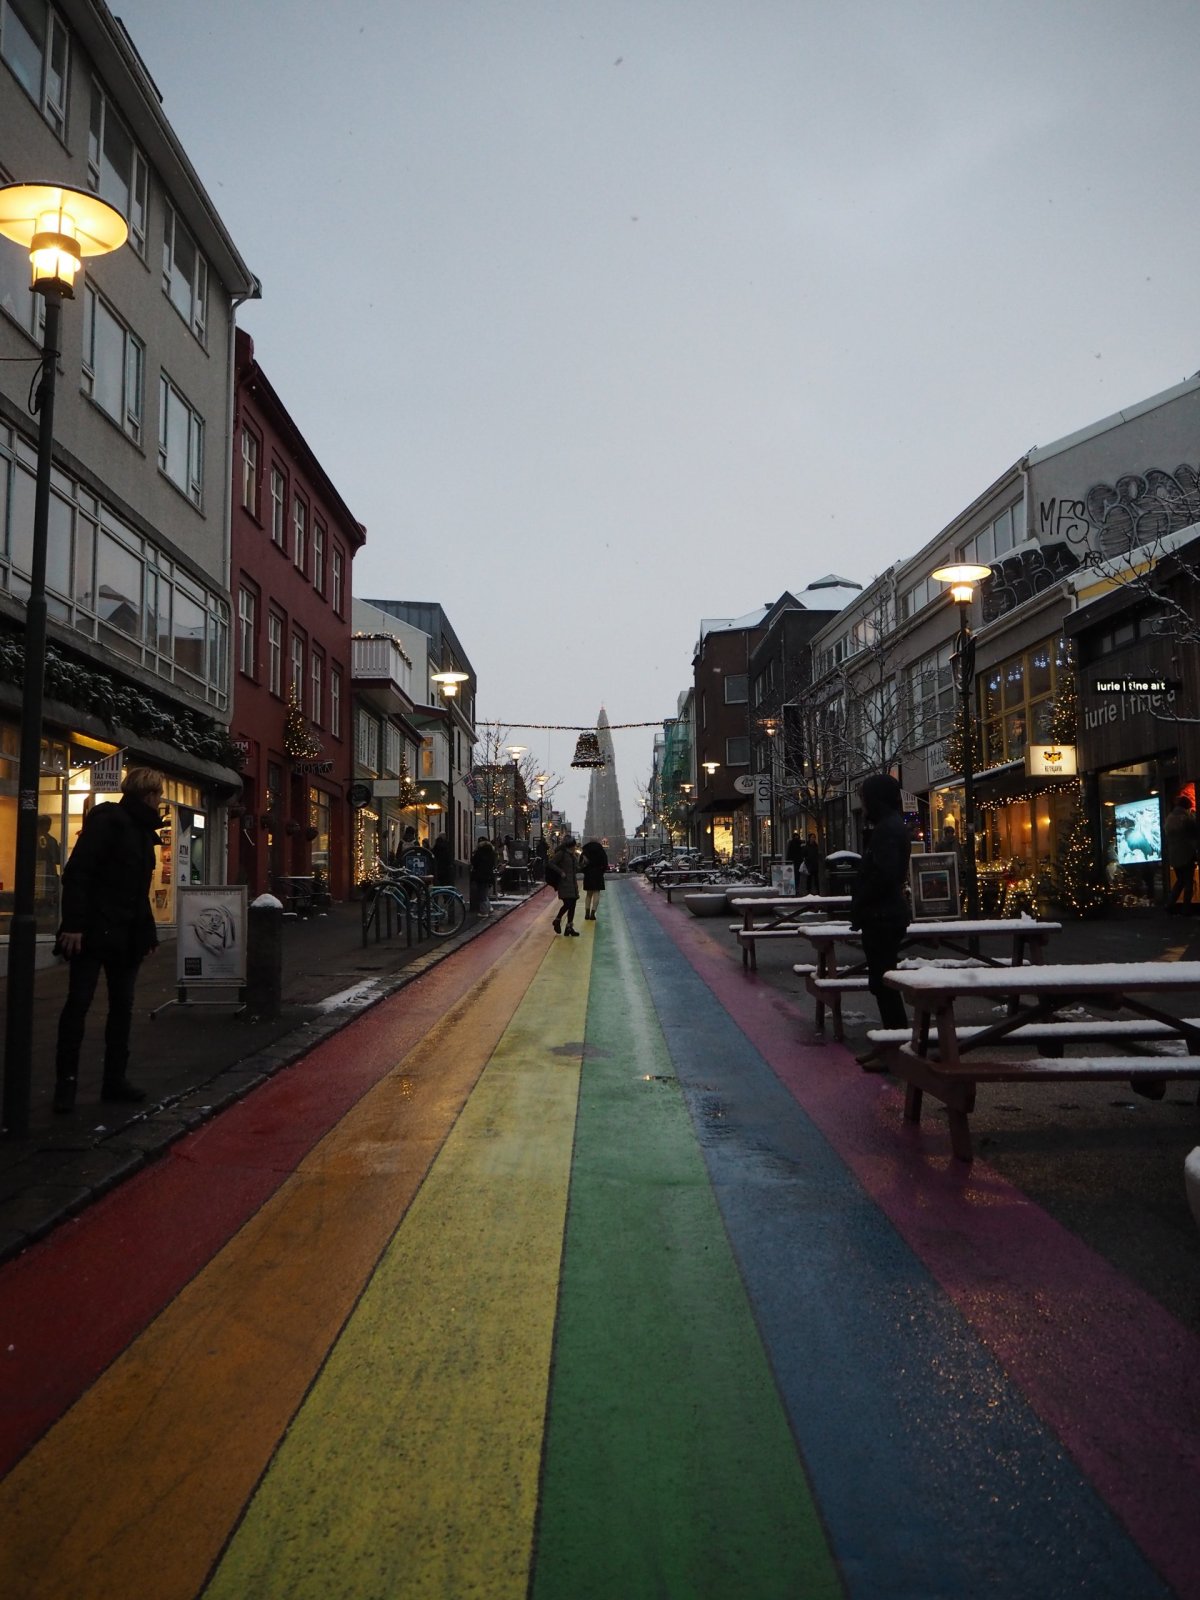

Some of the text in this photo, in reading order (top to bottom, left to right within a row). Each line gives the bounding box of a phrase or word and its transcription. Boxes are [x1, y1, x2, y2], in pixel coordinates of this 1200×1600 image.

[1040, 498, 1089, 543] MFS
[1096, 681, 1121, 691] iurie
[1084, 700, 1117, 730] iurie
[179, 844, 189, 856] ATM
